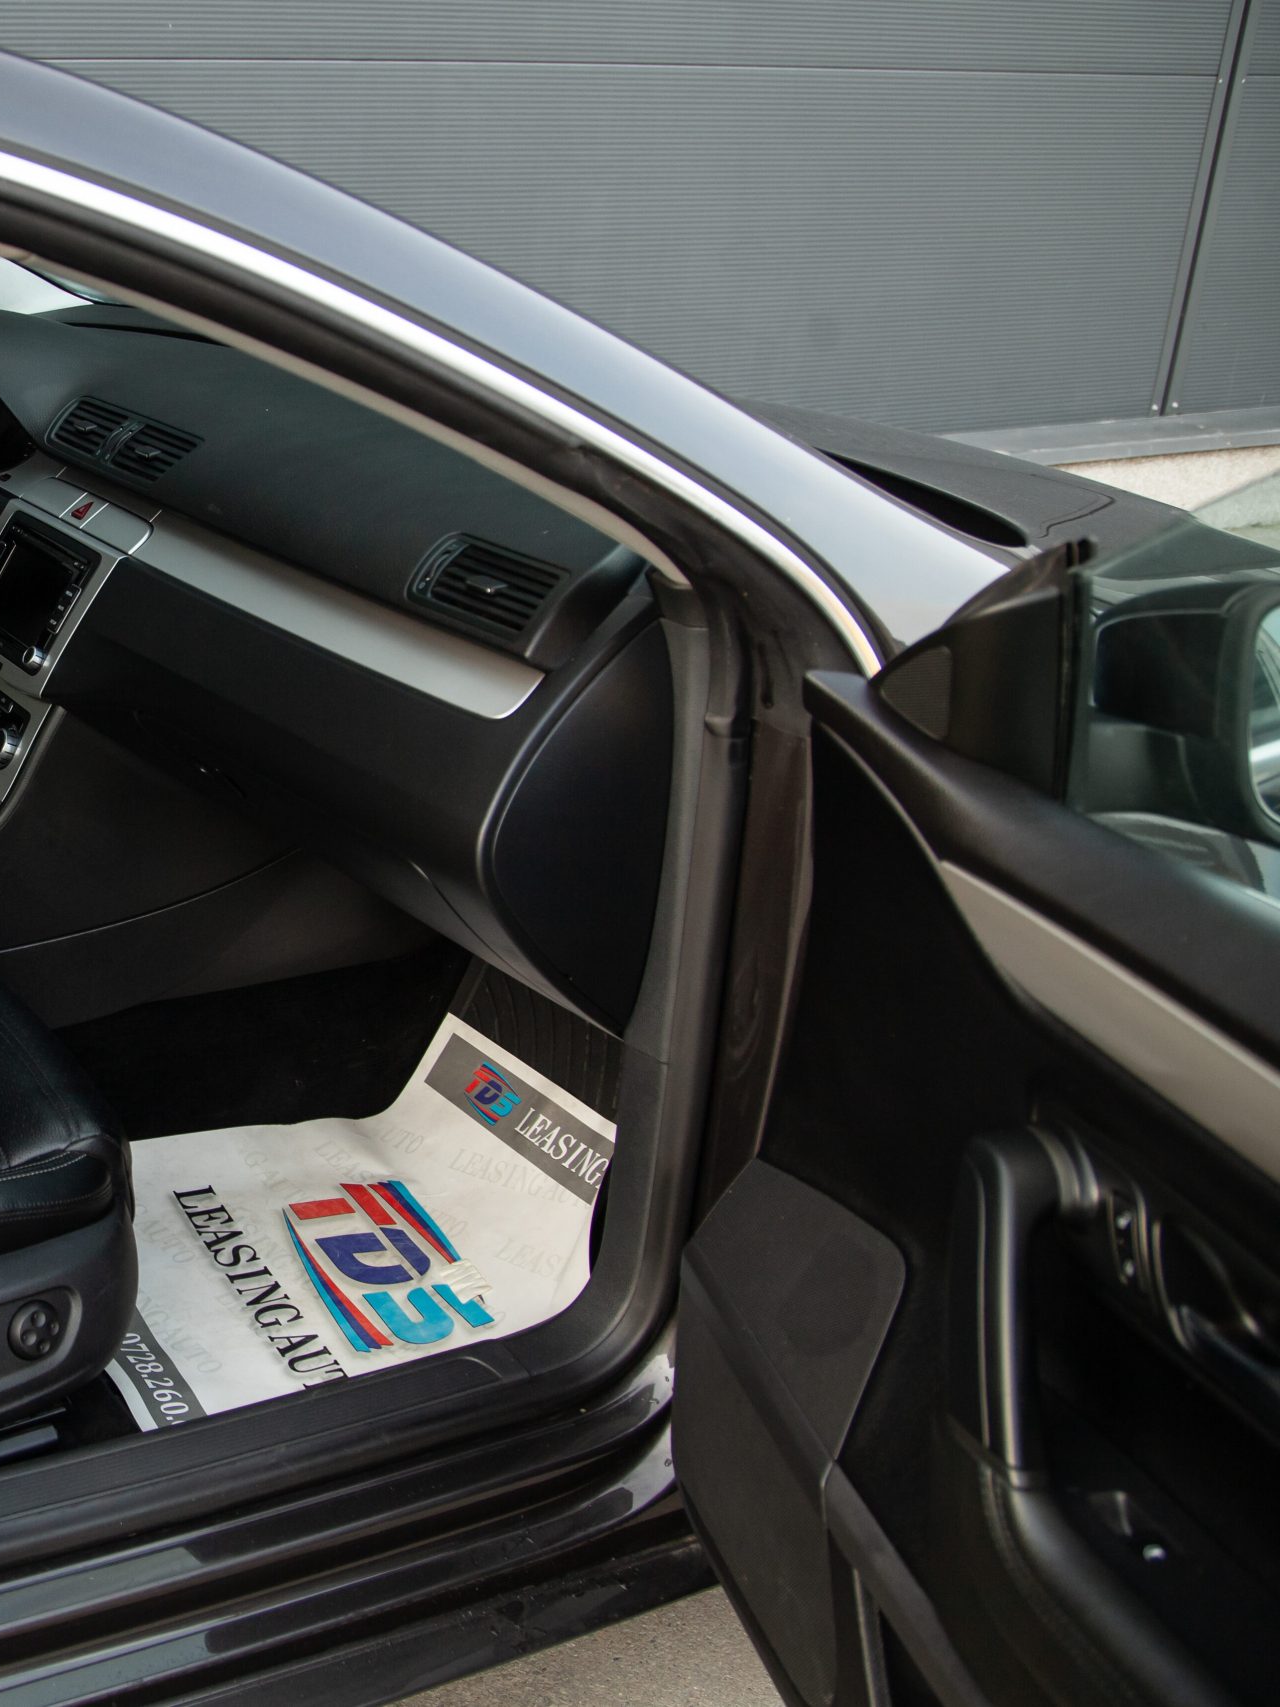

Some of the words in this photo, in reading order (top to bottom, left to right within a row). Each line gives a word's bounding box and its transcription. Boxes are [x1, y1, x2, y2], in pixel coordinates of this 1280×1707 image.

[464, 1066, 522, 1118] TDS
[514, 1107, 609, 1184] LEASING
[172, 1184, 304, 1329] LEASING
[288, 1182, 496, 1345] TDS
[120, 1332, 190, 1425] 0728.260.
